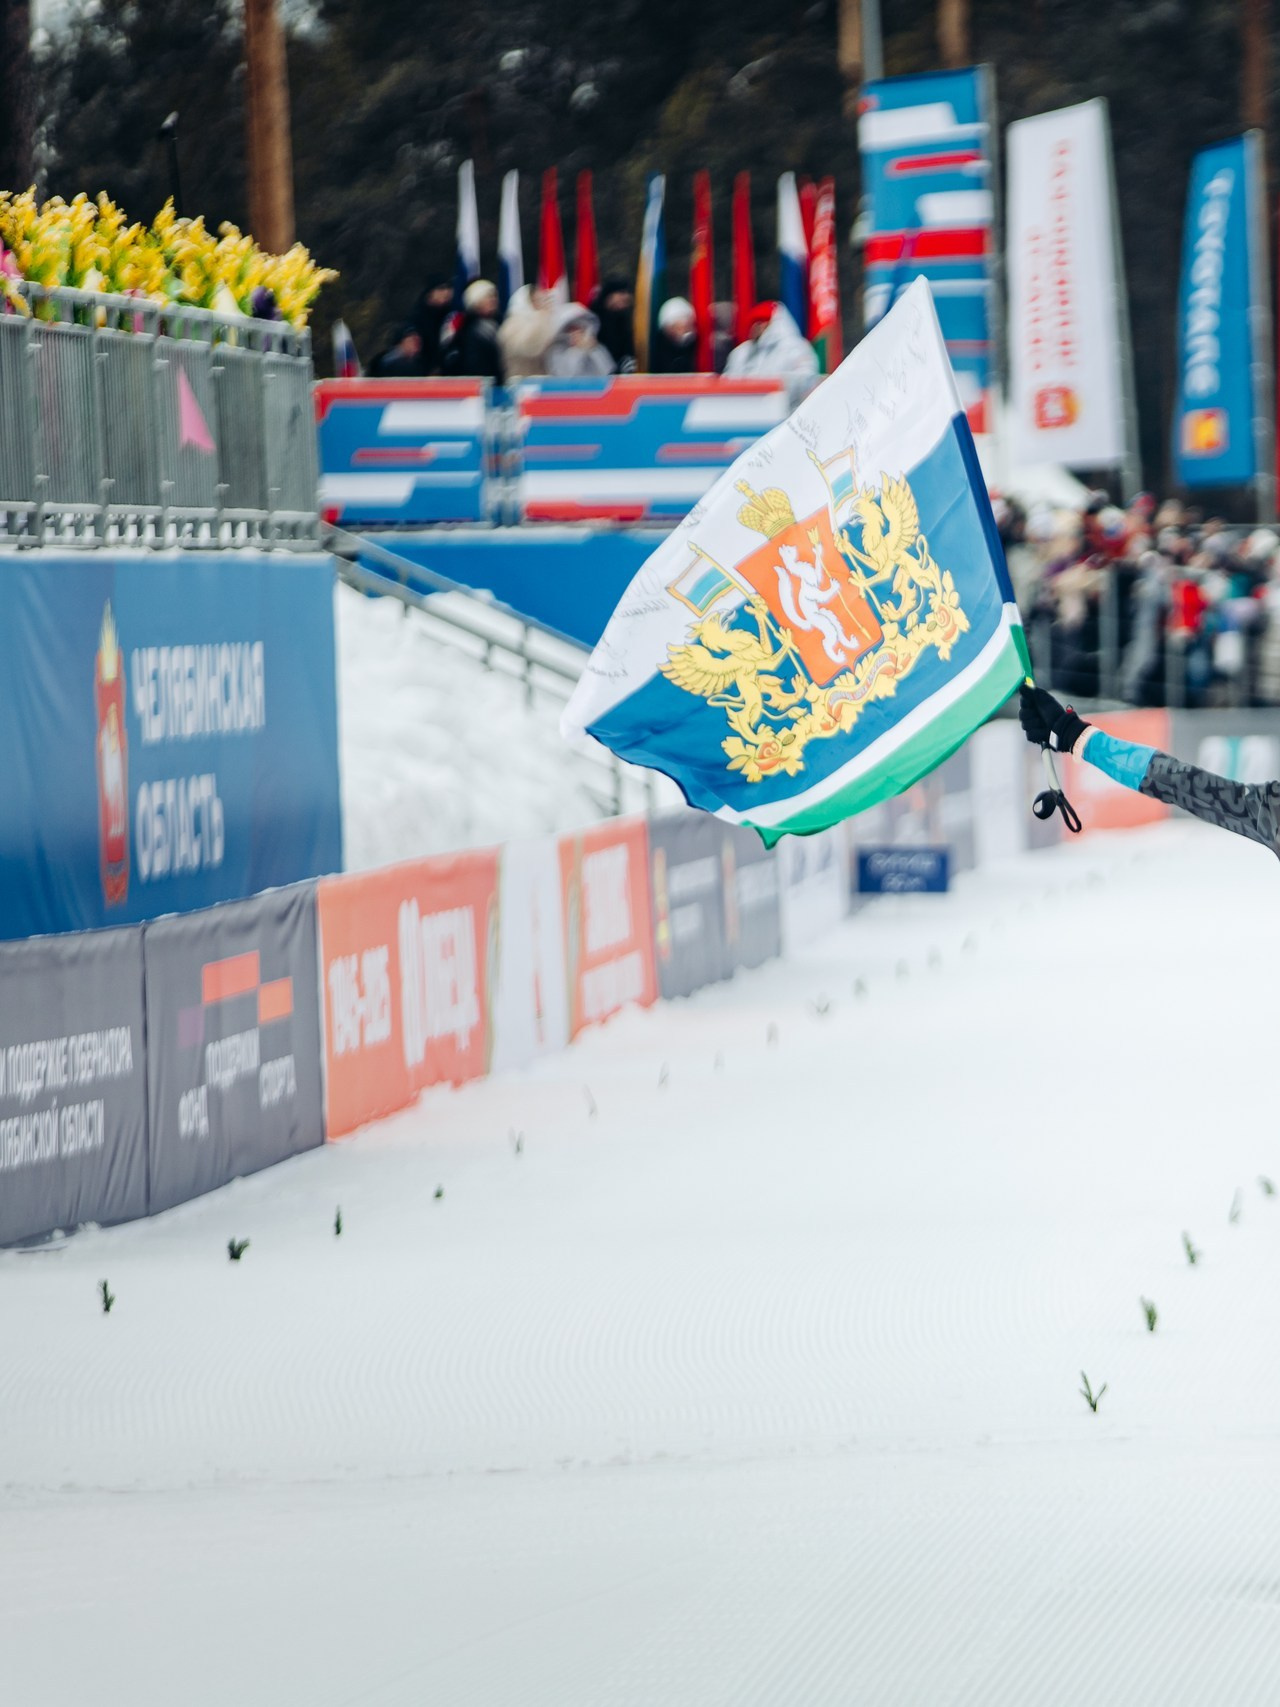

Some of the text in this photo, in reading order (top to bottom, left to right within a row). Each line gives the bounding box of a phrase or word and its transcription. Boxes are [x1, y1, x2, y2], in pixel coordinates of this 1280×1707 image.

[131, 641, 265, 745] ЧЕЛЯБИНСКАЯ
[136, 773, 224, 884] ОБЛАСТЬ
[60, 1098, 105, 1156] ОБЛАСТИ
